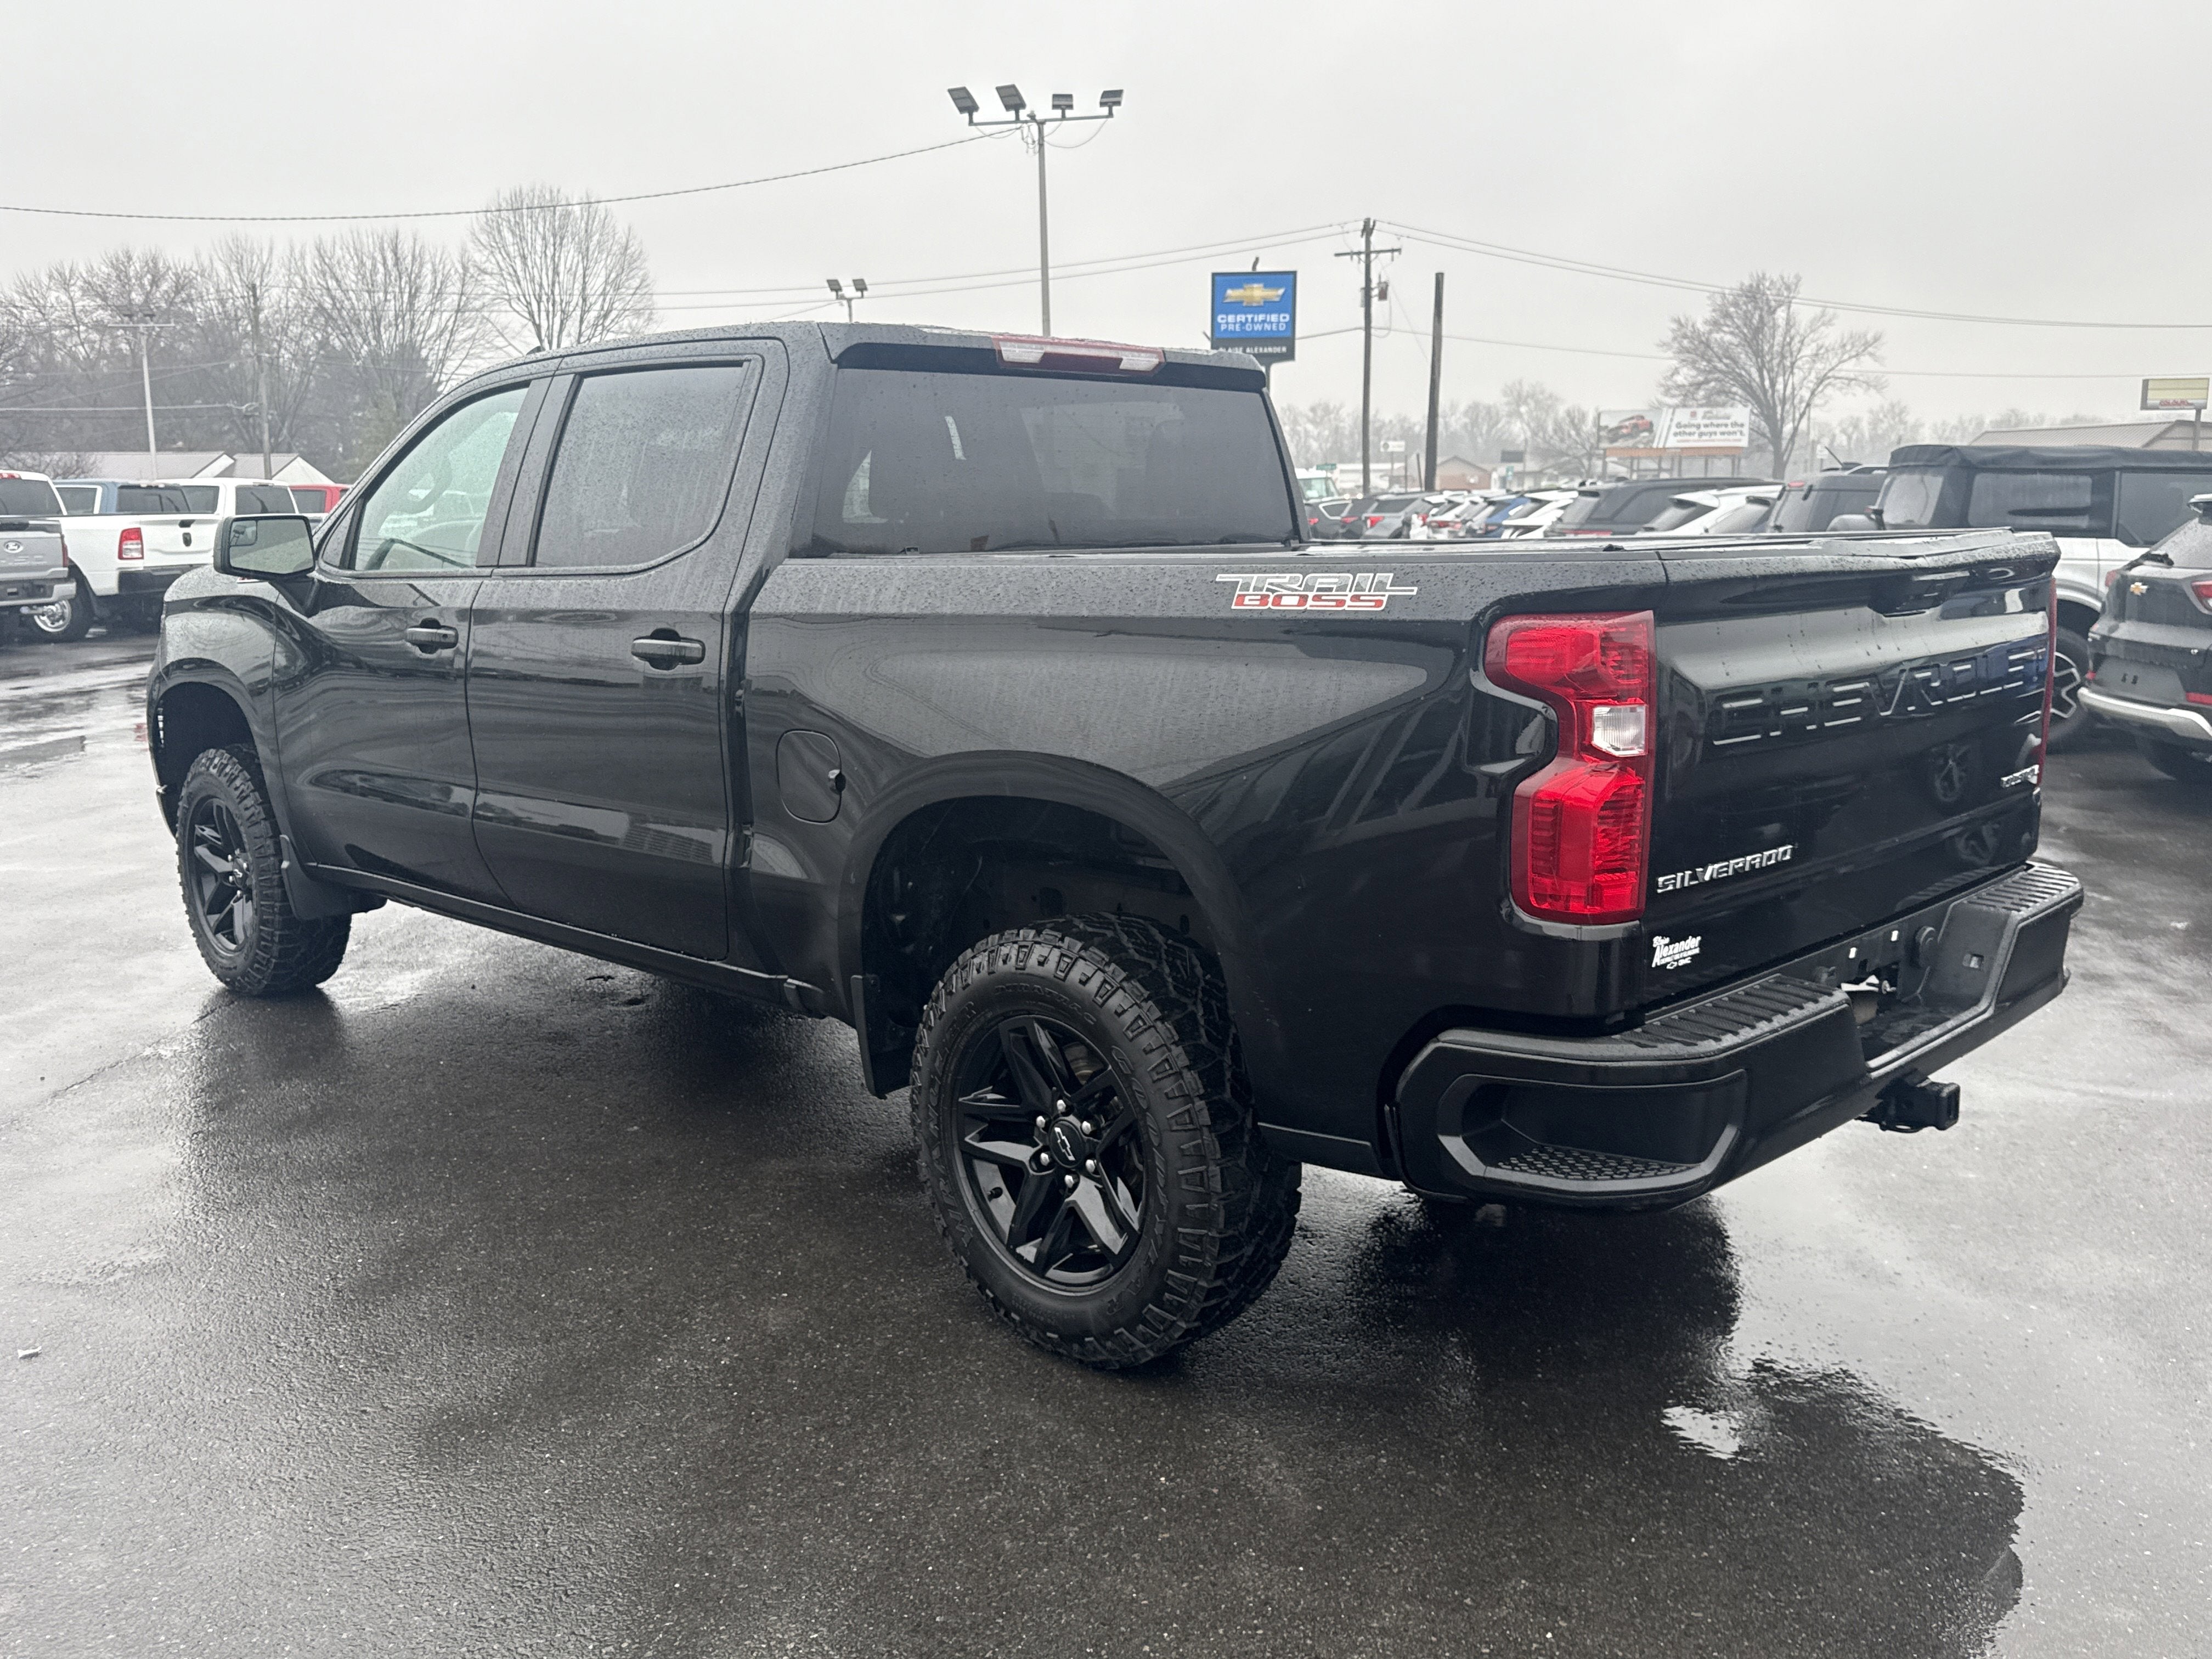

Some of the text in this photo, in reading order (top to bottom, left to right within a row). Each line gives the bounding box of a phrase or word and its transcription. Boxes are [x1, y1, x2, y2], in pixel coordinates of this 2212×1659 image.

[1217, 314, 1290, 323] CERTIFIED
[1221, 323, 1286, 331] PRE-OWNED
[1675, 421, 1701, 430] Going
[1215, 573, 1418, 595] TRAIL
[1231, 594, 1390, 611] BOSS
[1707, 645, 2047, 745] CHEVROLET
[1656, 844, 1794, 894] SILVERADO
[1652, 936, 1701, 967] Alexander
[1105, 1045, 1167, 1316] GOODYEAR
